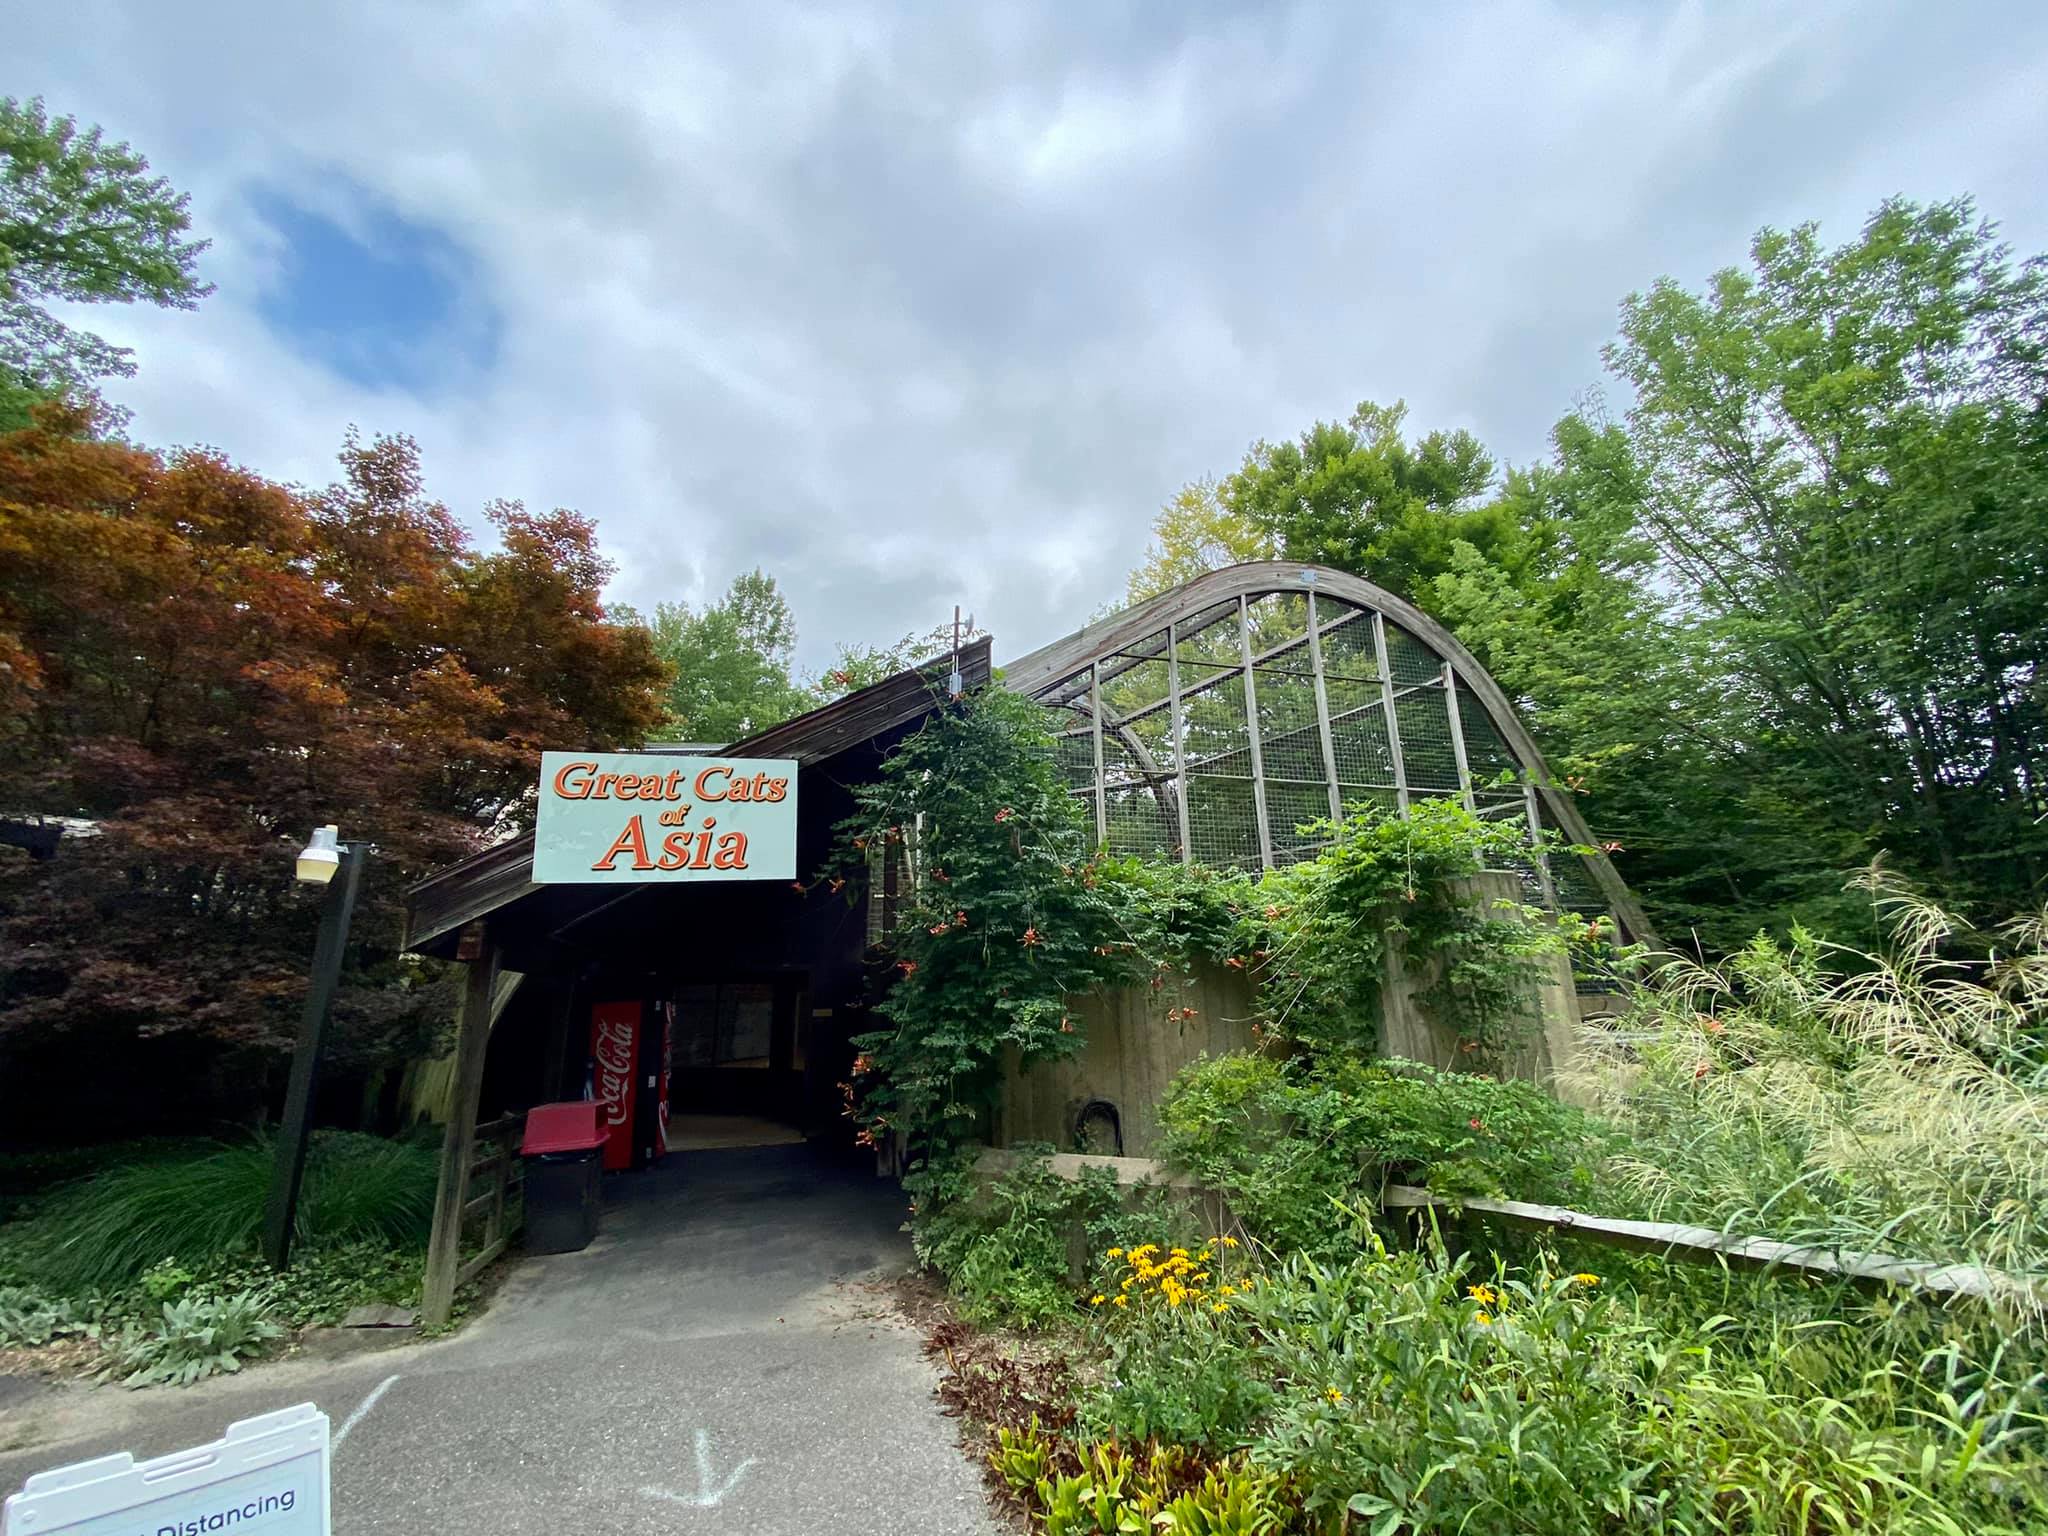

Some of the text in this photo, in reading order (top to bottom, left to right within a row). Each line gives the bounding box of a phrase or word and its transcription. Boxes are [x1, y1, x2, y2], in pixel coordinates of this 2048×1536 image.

[553, 761, 789, 801] Great Cats
[658, 804, 691, 825] of
[591, 815, 749, 872] Asia
